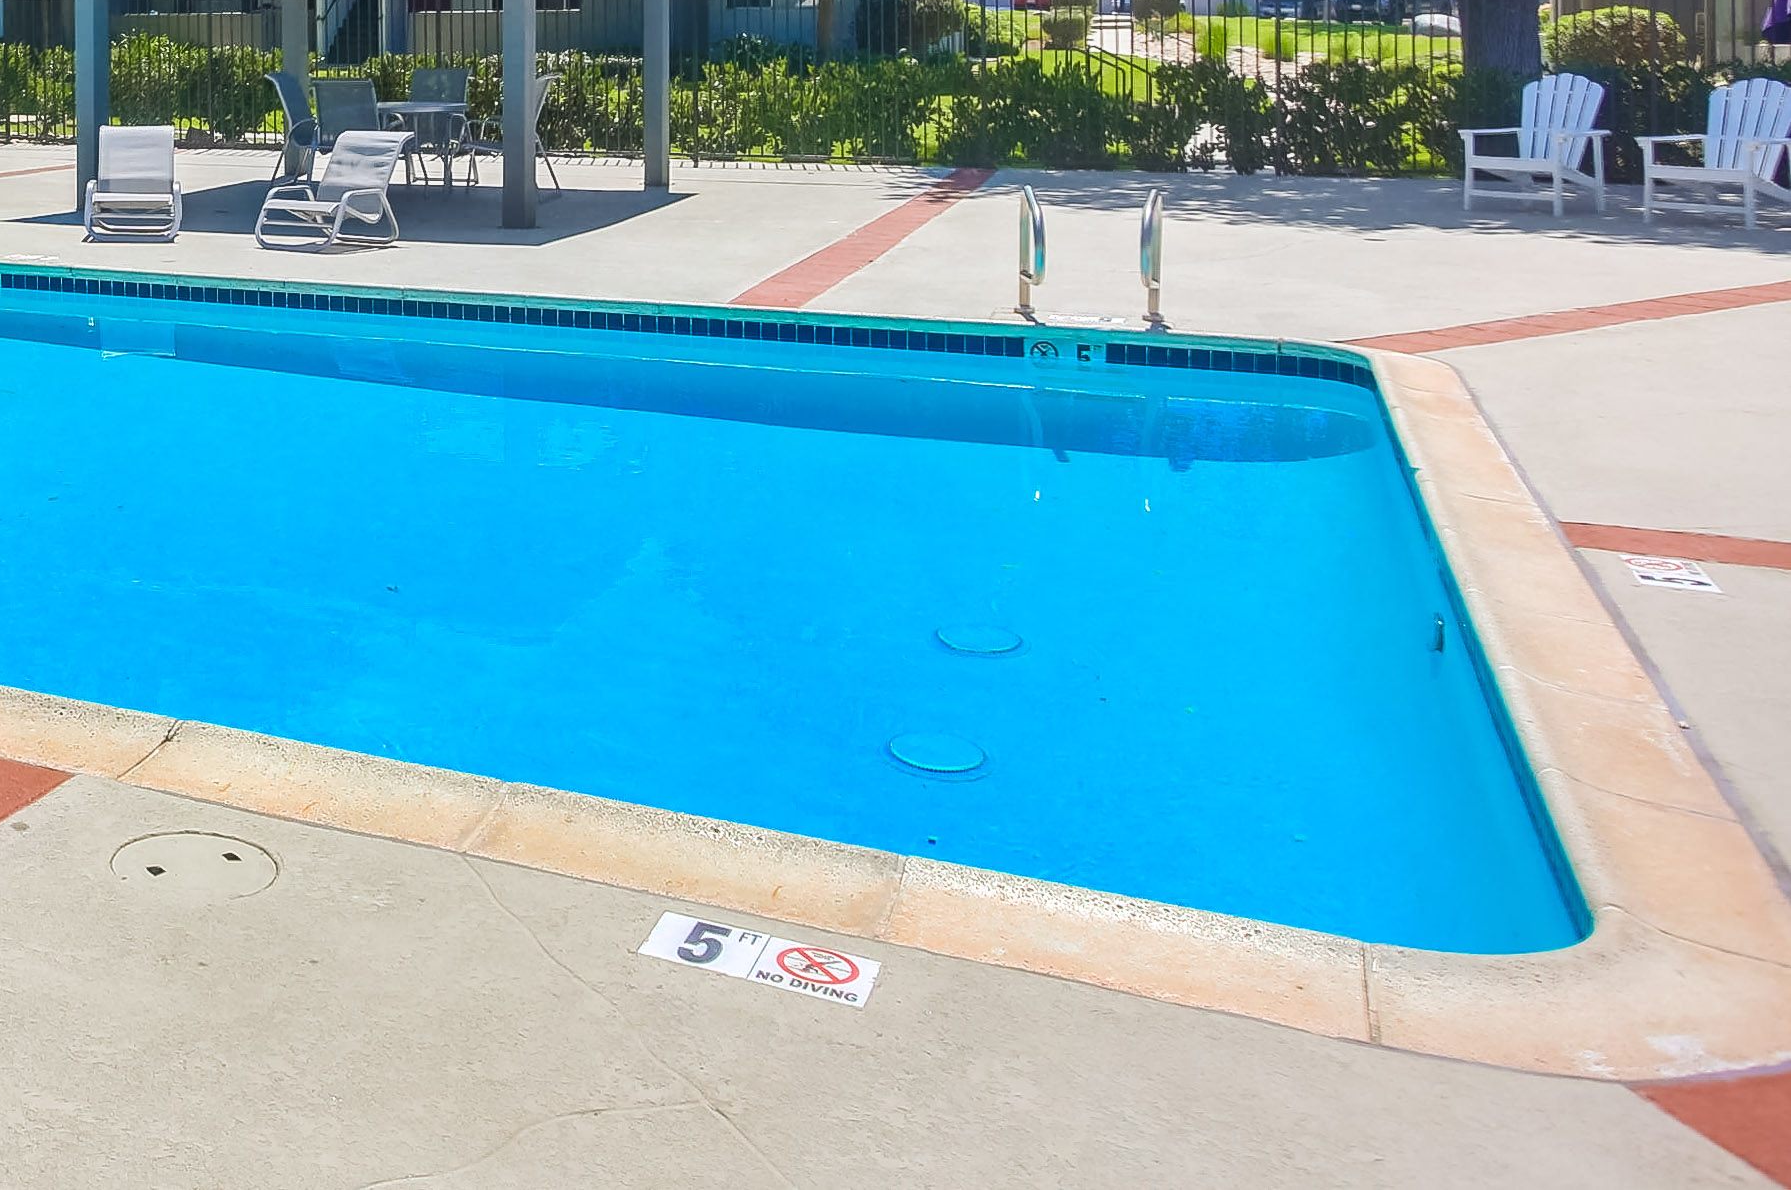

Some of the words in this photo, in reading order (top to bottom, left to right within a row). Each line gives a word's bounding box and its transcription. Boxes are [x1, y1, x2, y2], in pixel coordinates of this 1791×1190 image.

[677, 921, 732, 964] 5
[738, 931, 762, 946] FT
[755, 970, 784, 984] NO
[789, 978, 859, 1002] DIVING
